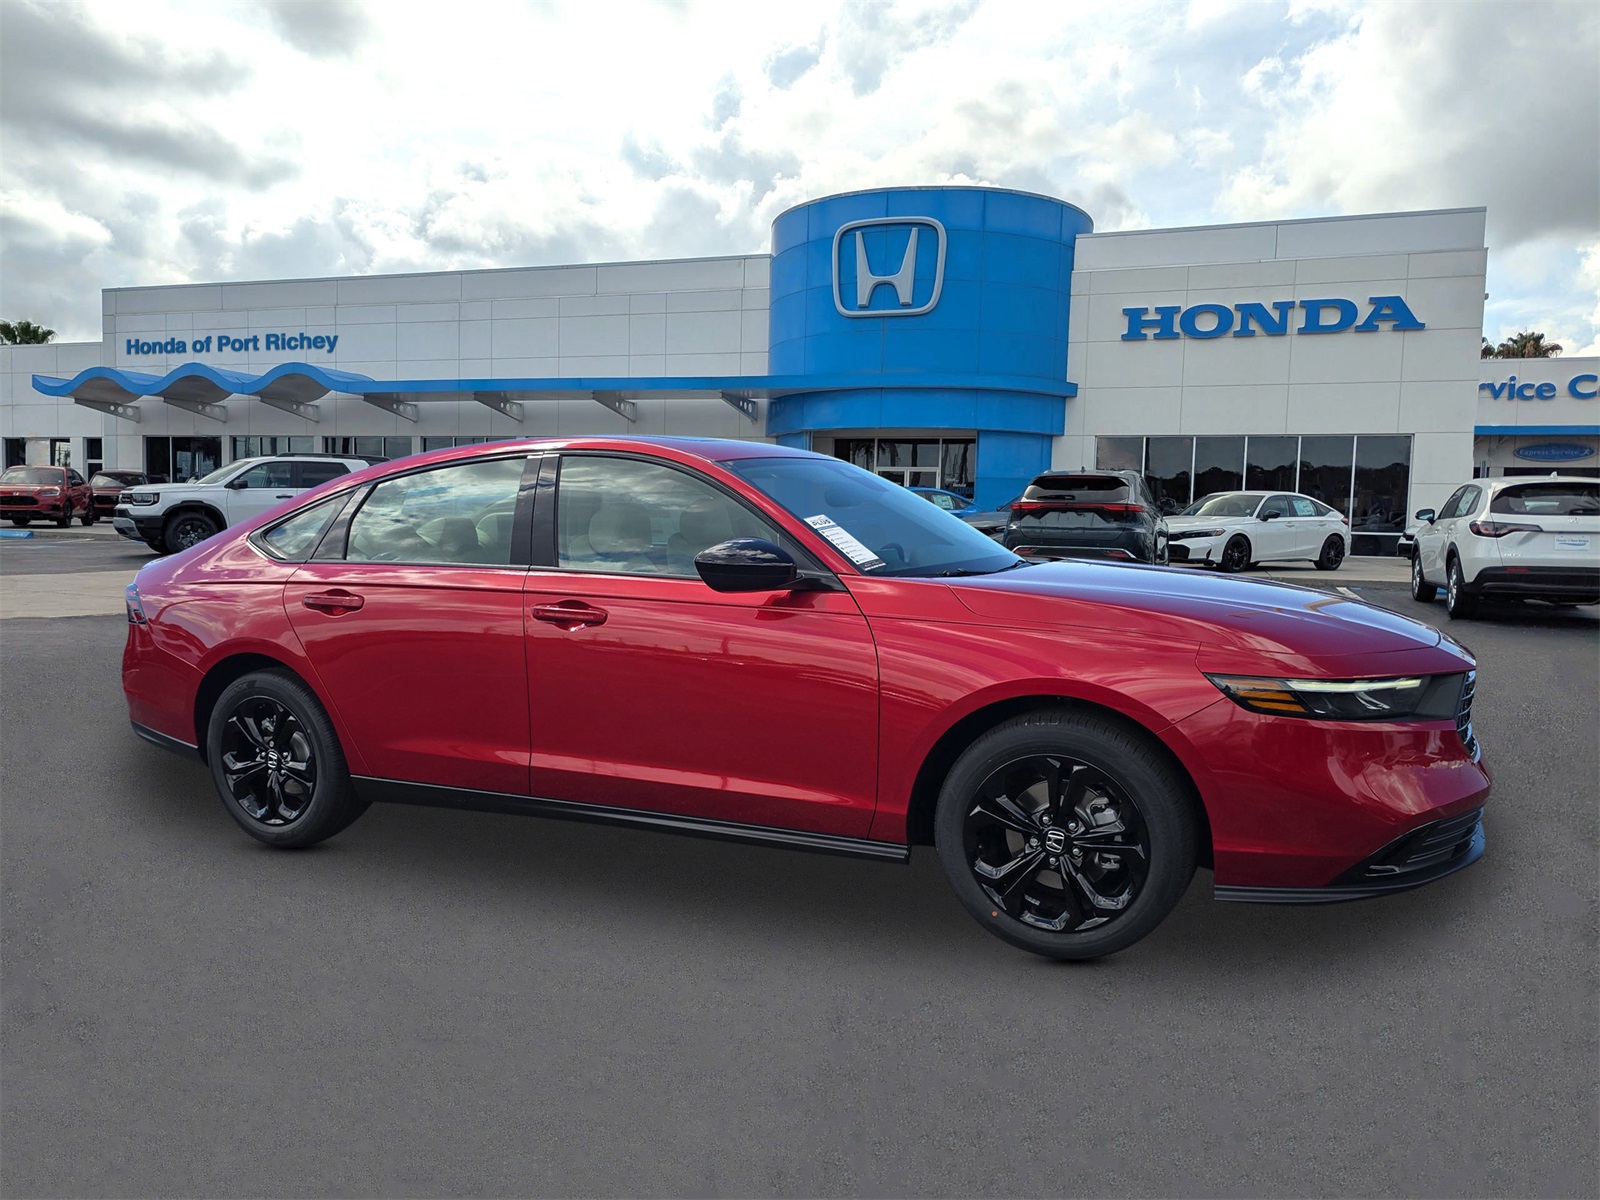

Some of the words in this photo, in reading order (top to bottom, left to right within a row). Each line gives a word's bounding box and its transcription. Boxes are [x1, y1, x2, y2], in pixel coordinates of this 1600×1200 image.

[1121, 295, 1425, 341] HONDA
[126, 337, 187, 355] Honda
[192, 335, 213, 353] of
[217, 335, 260, 352] Port
[265, 332, 339, 353] Richey
[1568, 374, 1600, 400] C
[1519, 448, 1549, 457] Express
[1550, 448, 1579, 456] Service
